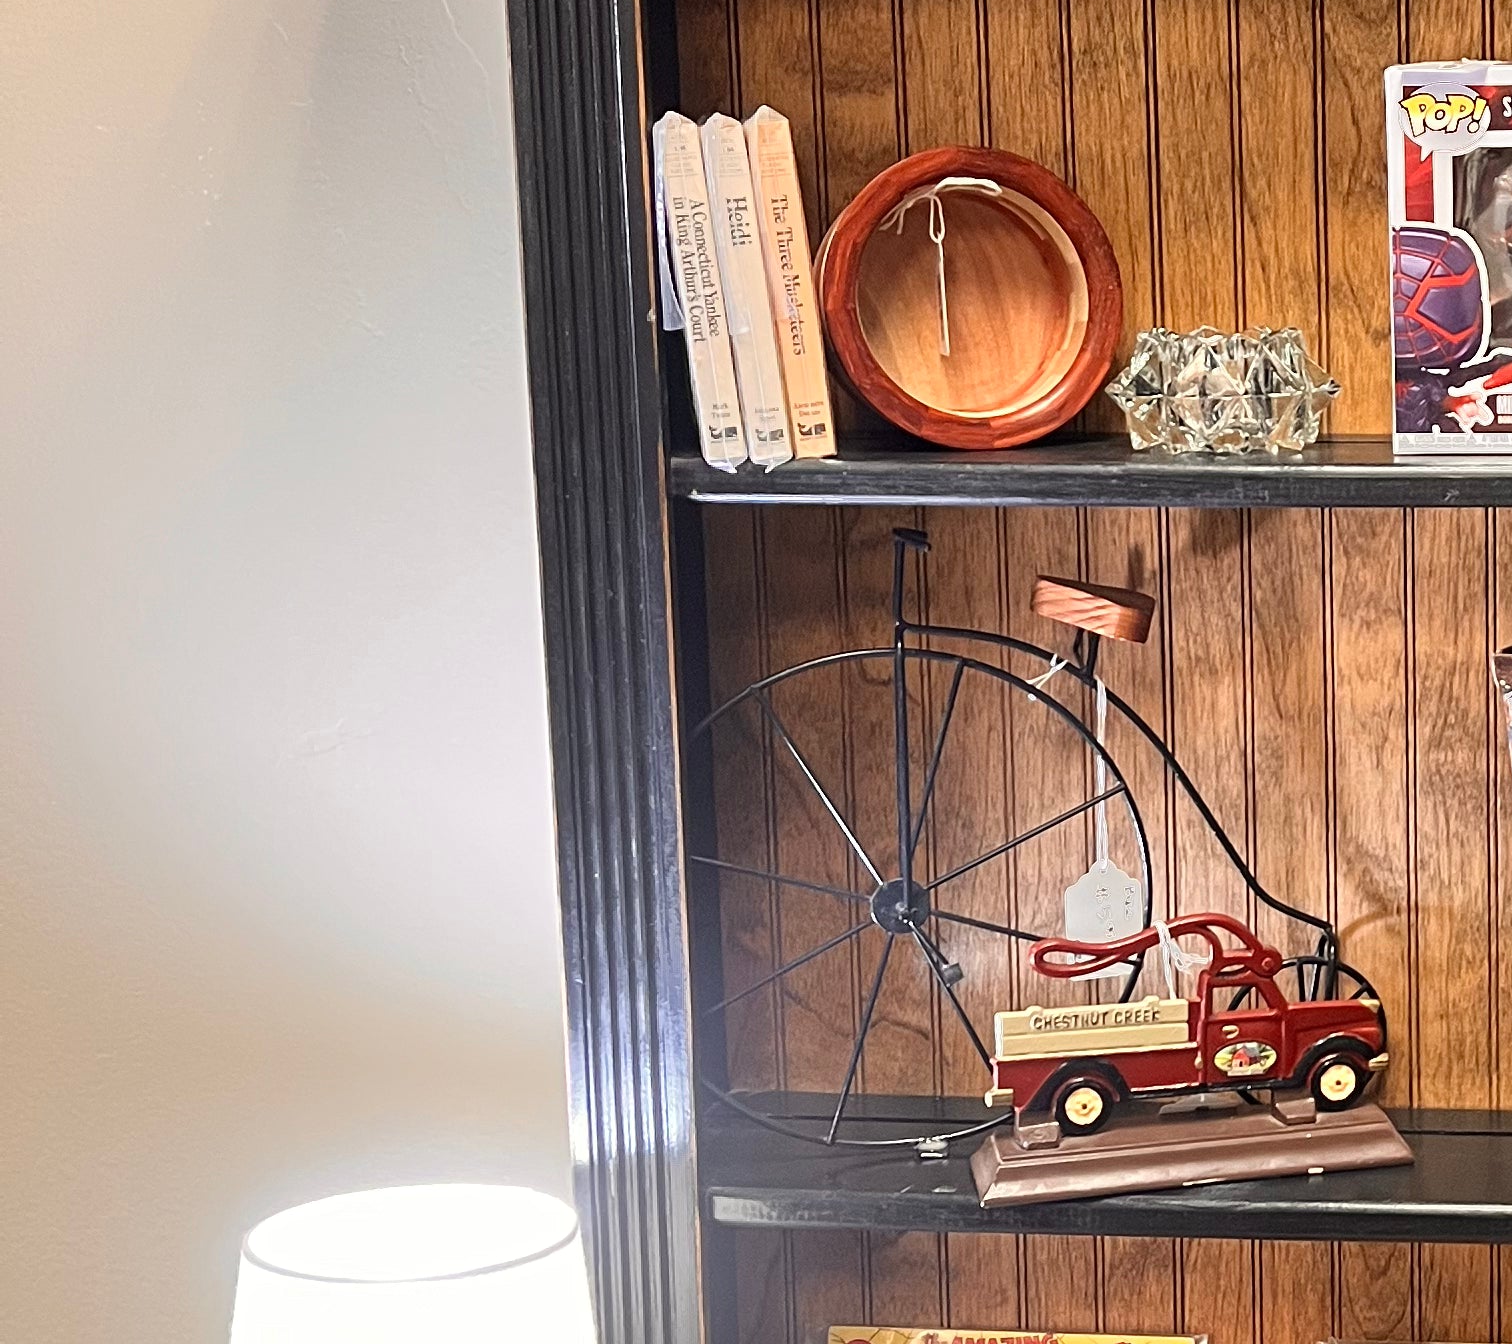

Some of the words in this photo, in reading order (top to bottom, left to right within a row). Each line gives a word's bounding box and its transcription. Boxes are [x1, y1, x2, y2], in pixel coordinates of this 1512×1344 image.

[1398, 93, 1488, 138] POP!
[673, 213, 690, 247] King
[726, 197, 752, 248] Heidi
[770, 194, 788, 224] The
[690, 210, 716, 289] Connecticut
[775, 226, 794, 272] Three
[680, 246, 700, 302] Arthur's
[689, 302, 707, 344] Court
[702, 288, 721, 338] Yankee
[1033, 1012, 1108, 1030] CHESTNUT
[1114, 1009, 1160, 1024] CREEK
